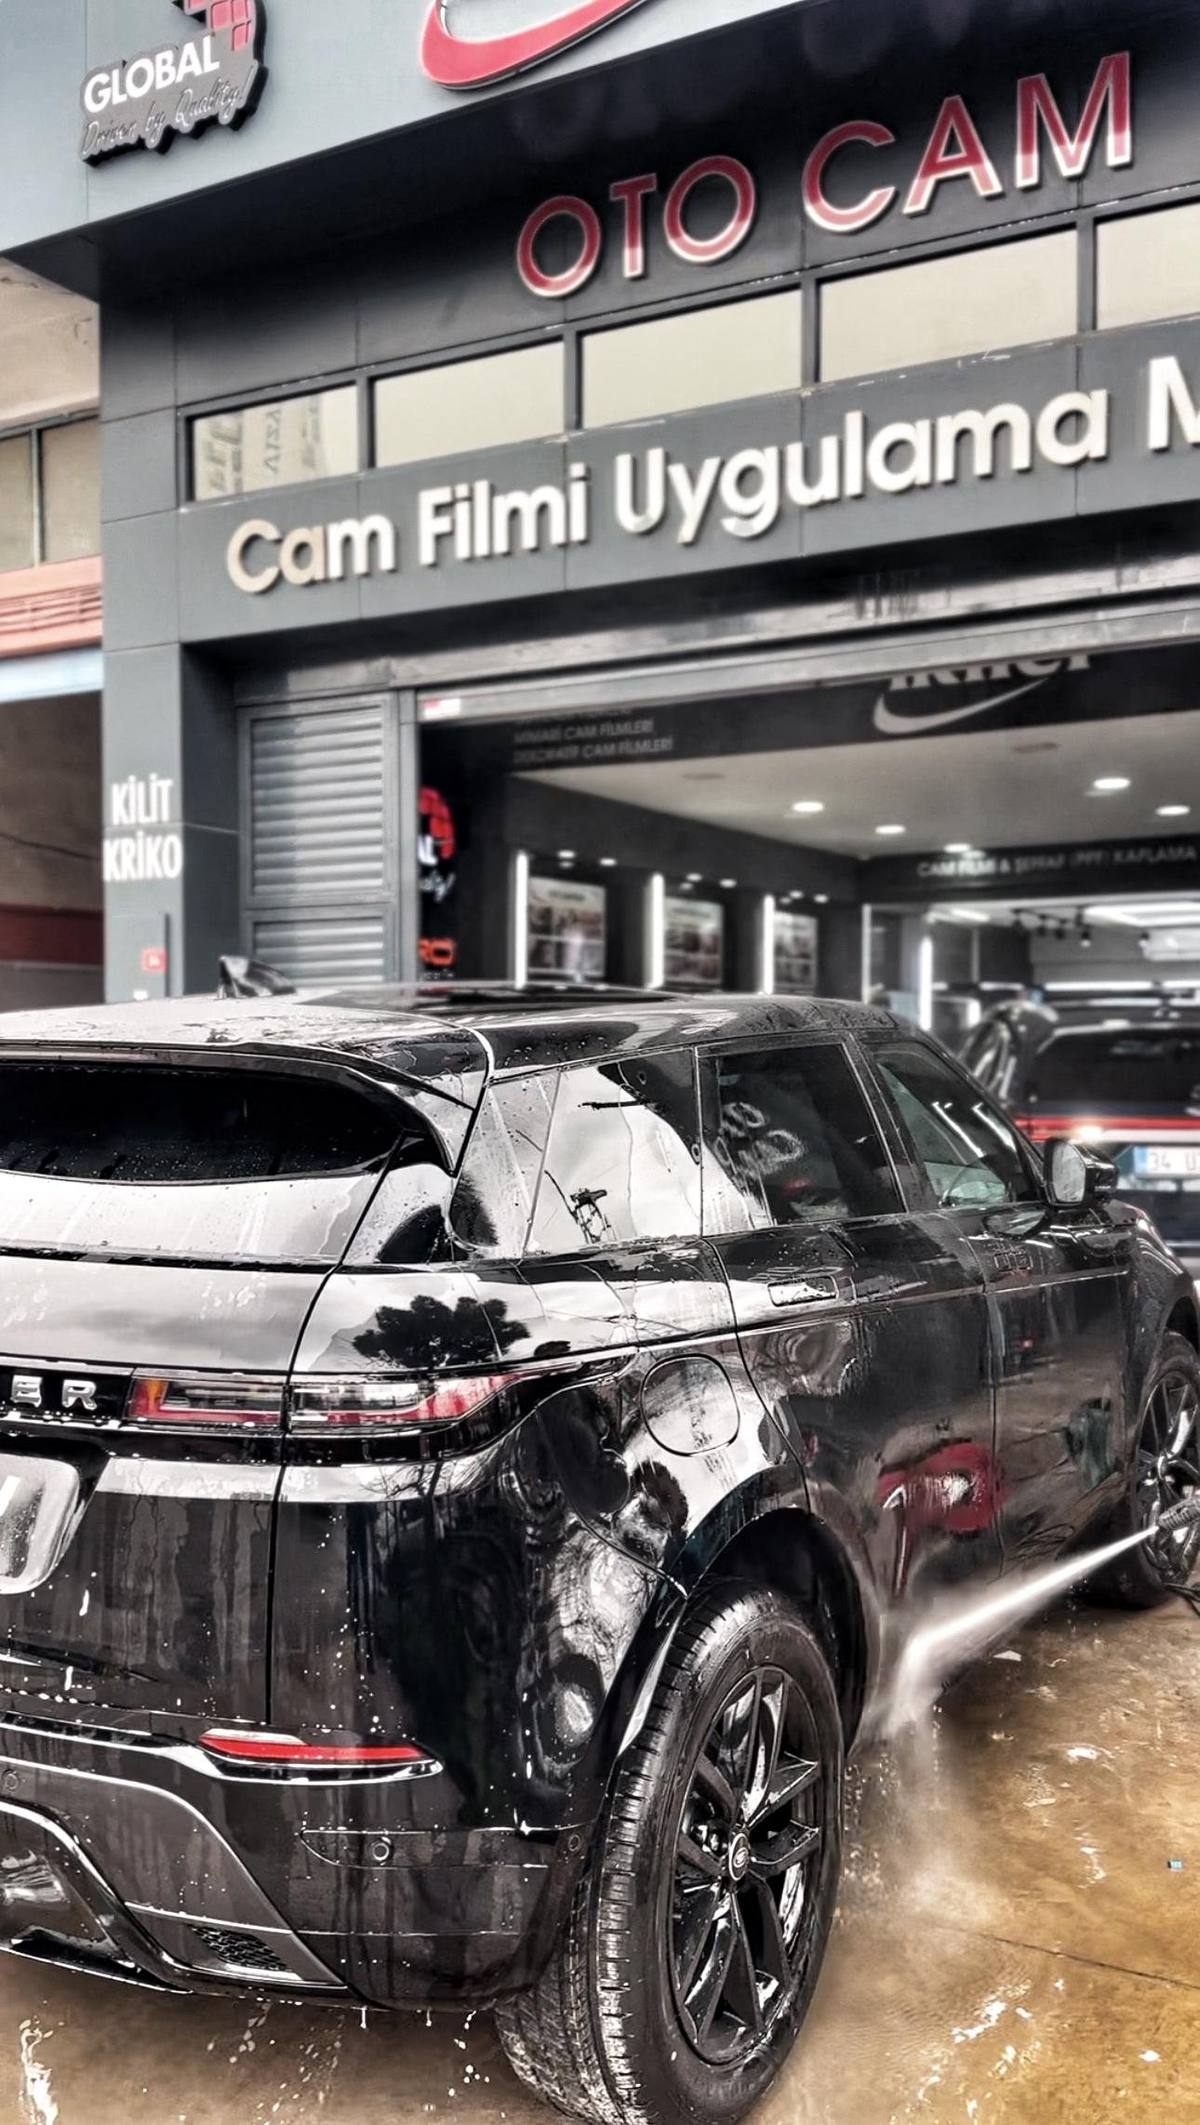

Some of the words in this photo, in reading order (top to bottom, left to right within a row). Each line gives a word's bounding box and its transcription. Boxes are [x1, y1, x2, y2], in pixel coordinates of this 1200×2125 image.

[84, 35, 220, 113] GLOBAL
[80, 120, 138, 155] Driven
[144, 101, 167, 145] by
[516, 154, 756, 298] OTO
[803, 51, 1134, 233] CAM
[226, 514, 398, 594] Cam
[418, 462, 589, 566] Filmi
[615, 389, 1108, 545] Uygulama
[111, 773, 174, 826] KİLİT
[103, 830, 183, 882] KRİKO
[1150, 1152, 1172, 1169] 34
